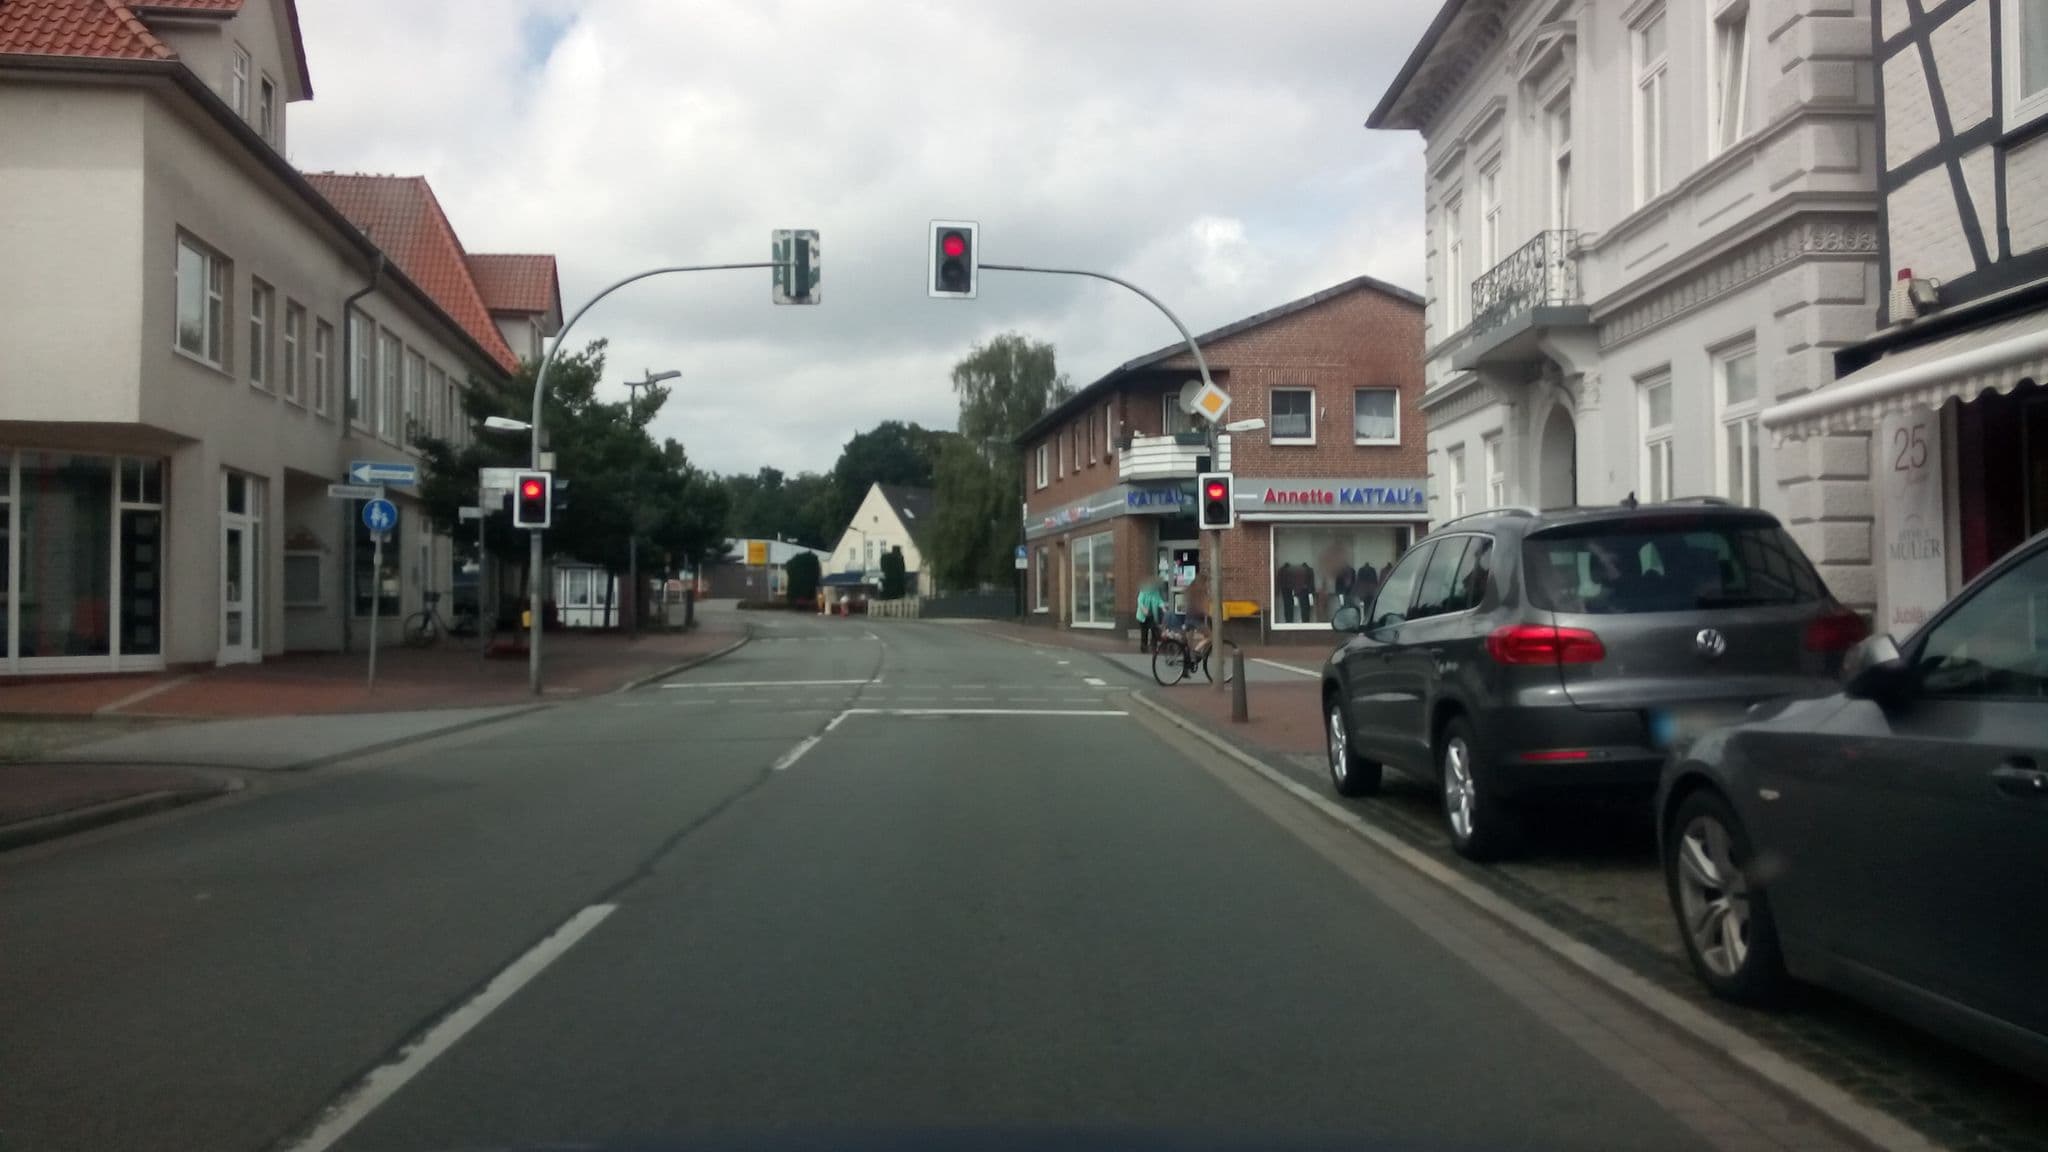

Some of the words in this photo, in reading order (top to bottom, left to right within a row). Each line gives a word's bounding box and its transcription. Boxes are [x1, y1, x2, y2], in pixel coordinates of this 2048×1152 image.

[1894, 424, 1928, 472] 25
[1264, 487, 1334, 505] Annette
[1340, 486, 1423, 505] KATTAU's
